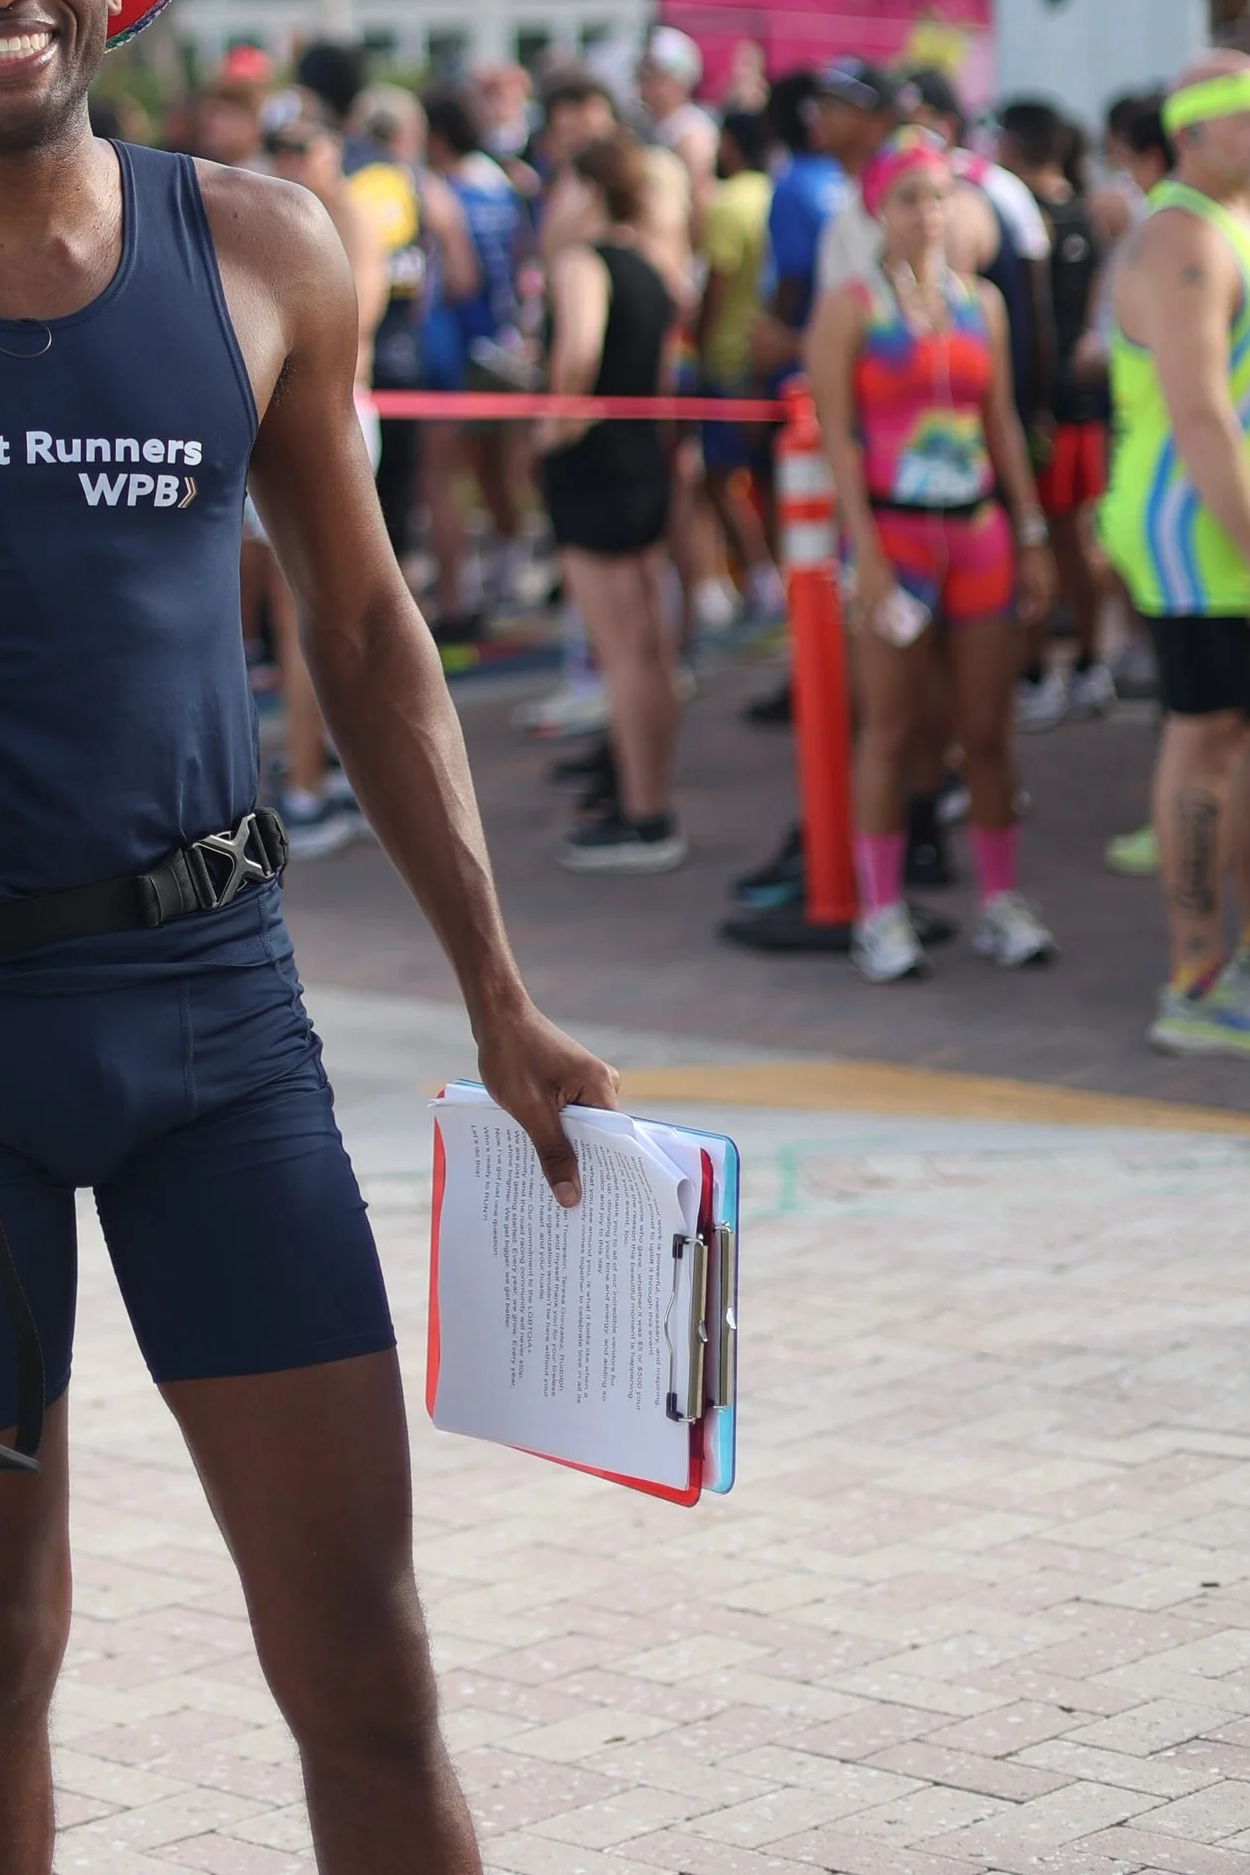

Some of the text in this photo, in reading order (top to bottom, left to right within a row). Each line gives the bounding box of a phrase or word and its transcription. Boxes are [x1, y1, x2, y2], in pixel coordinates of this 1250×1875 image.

[25, 429, 203, 467] Runners
[78, 472, 181, 509] WPB
[494, 1127, 502, 1146] Now
[513, 1130, 520, 1144] We
[511, 1181, 519, 1210] getting
[504, 1207, 511, 1221] We
[512, 1298, 517, 1312] we
[510, 1340, 518, 1364] Every
